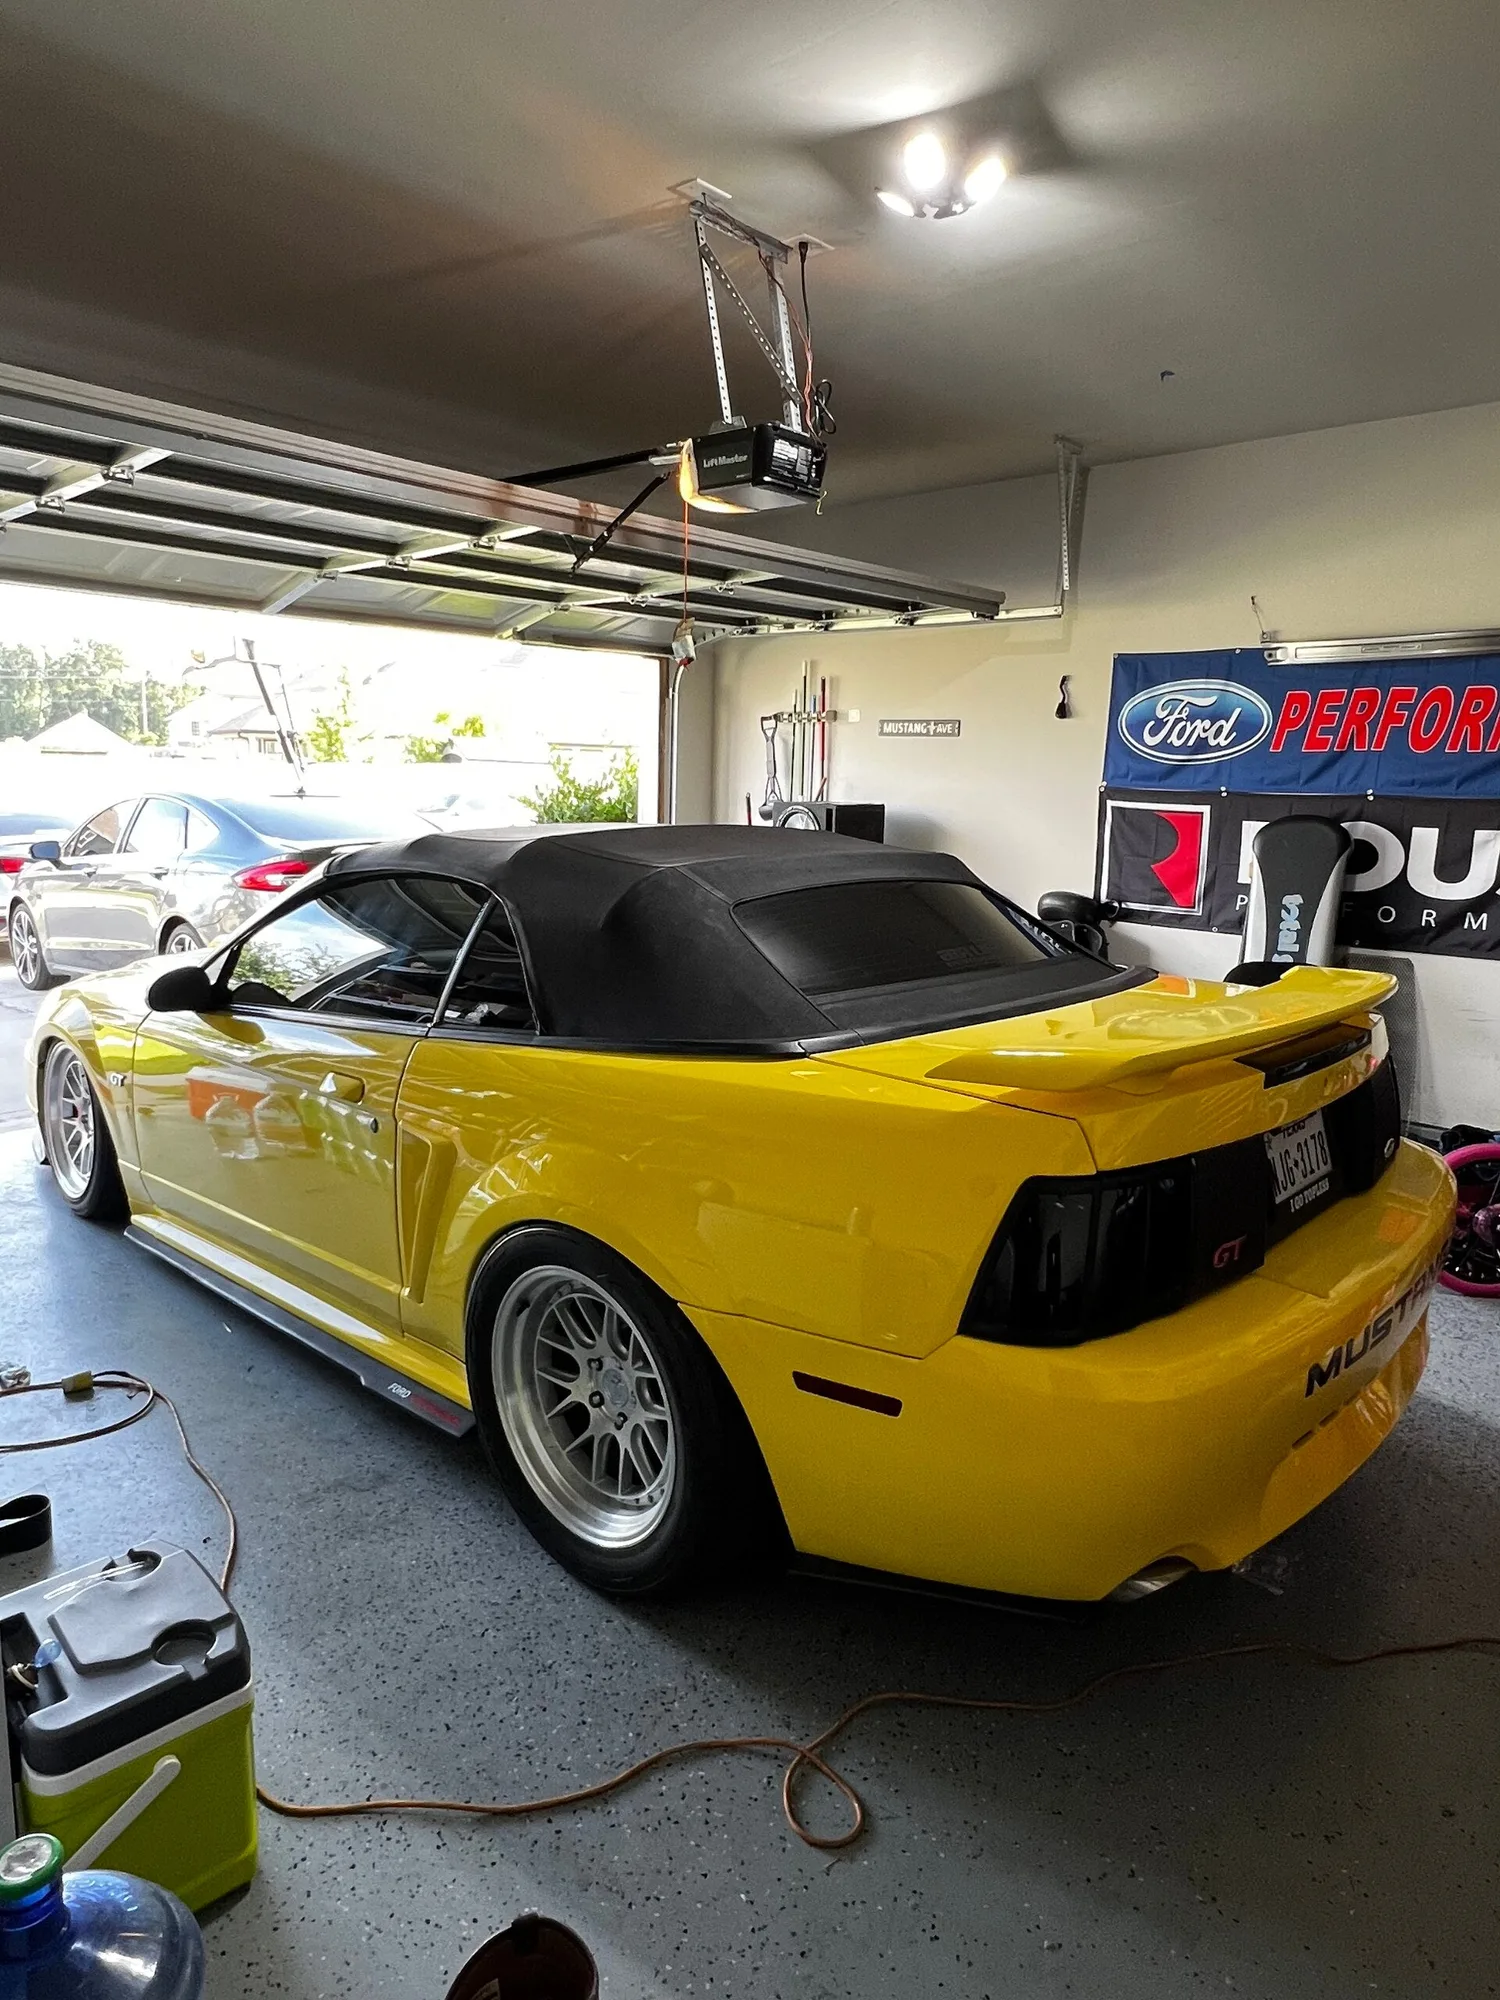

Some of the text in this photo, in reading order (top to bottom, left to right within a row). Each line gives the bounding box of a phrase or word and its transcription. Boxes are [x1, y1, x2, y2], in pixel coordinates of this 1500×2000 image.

[703, 453, 748, 468] LiftMaster
[1143, 685, 1500, 754] Ford PERFOR
[883, 722, 953, 734] MUSTANG AVE
[110, 1072, 127, 1087] GT
[1213, 1232, 1248, 1268] GT
[387, 1382, 412, 1398] FORD
